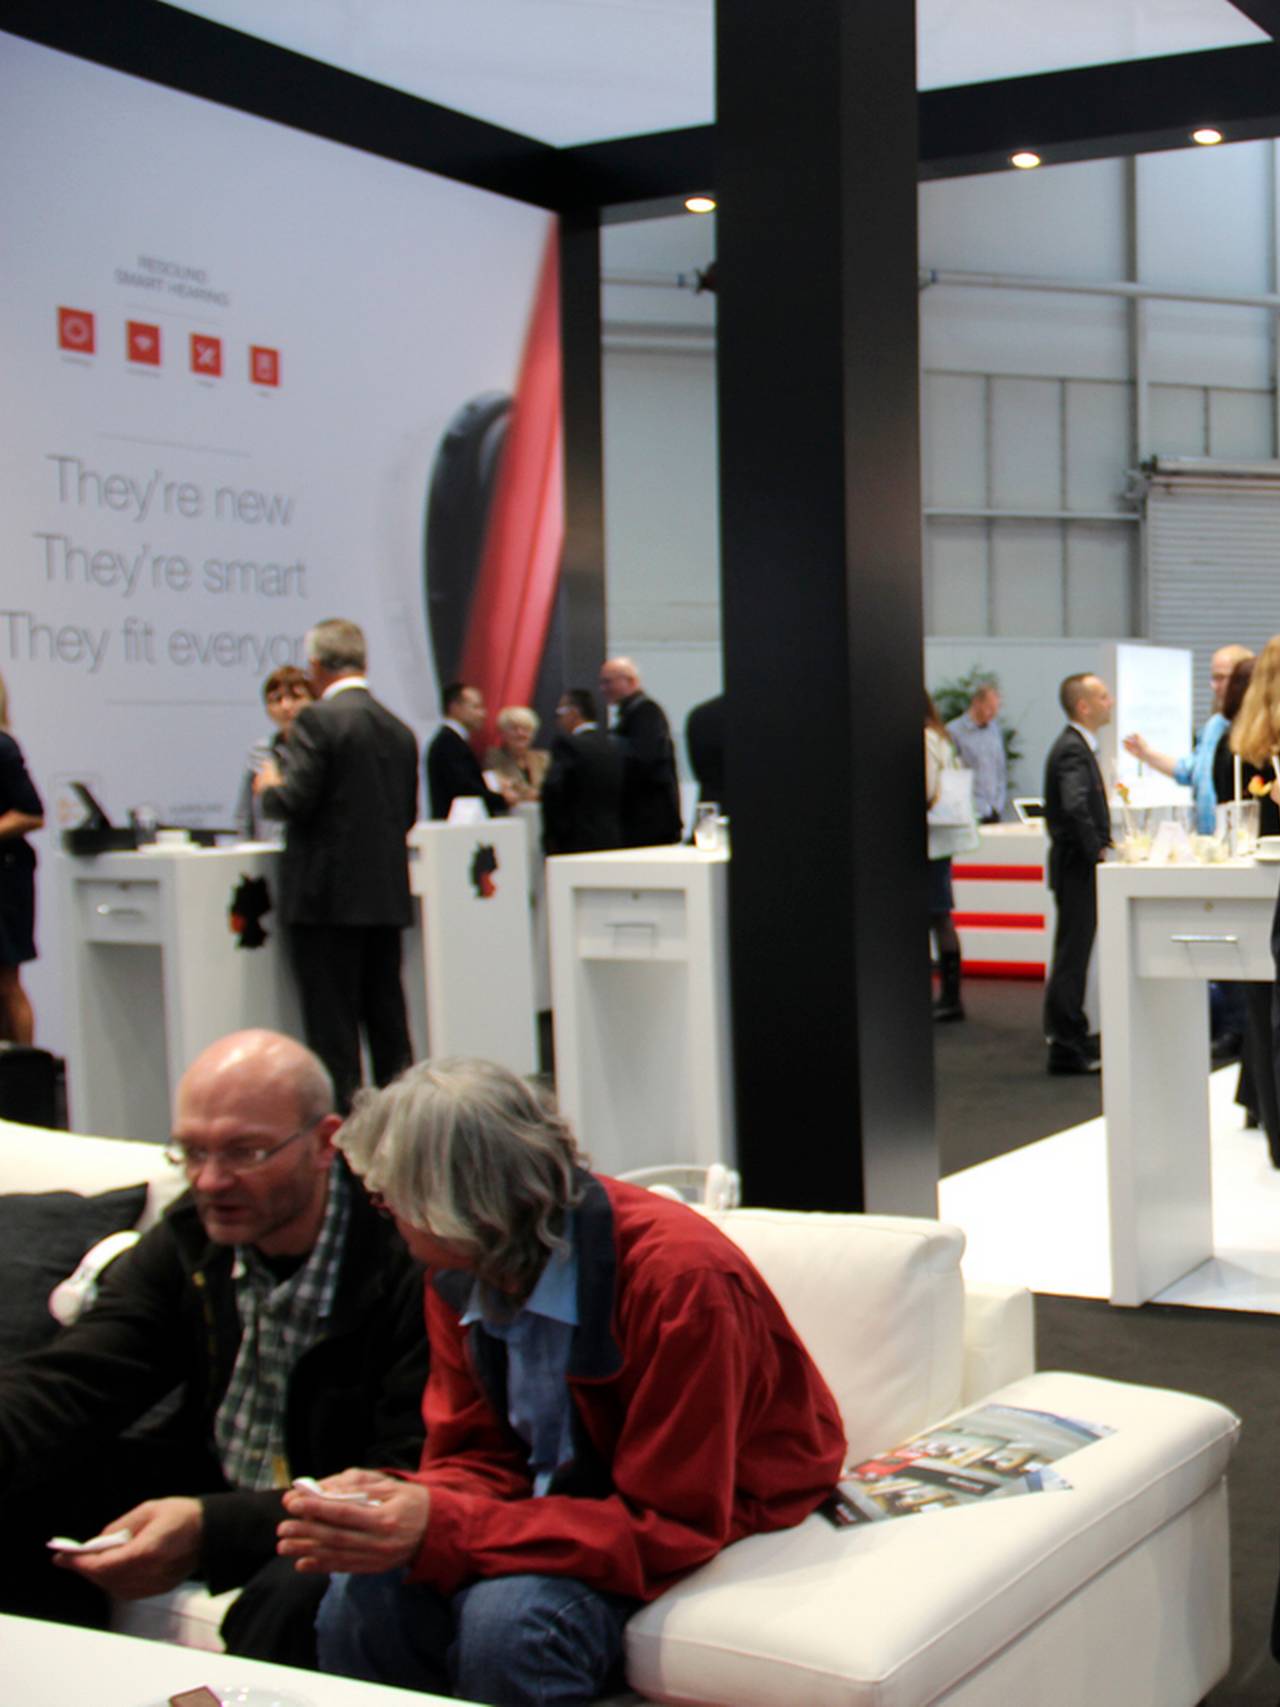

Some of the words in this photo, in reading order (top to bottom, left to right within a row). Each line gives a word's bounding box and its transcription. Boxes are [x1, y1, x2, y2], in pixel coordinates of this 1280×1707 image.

[46, 453, 201, 522] They're
[214, 485, 296, 526] new
[33, 532, 192, 597] They're
[202, 556, 307, 599] smart
[0, 609, 110, 674] They
[122, 615, 156, 665] fit
